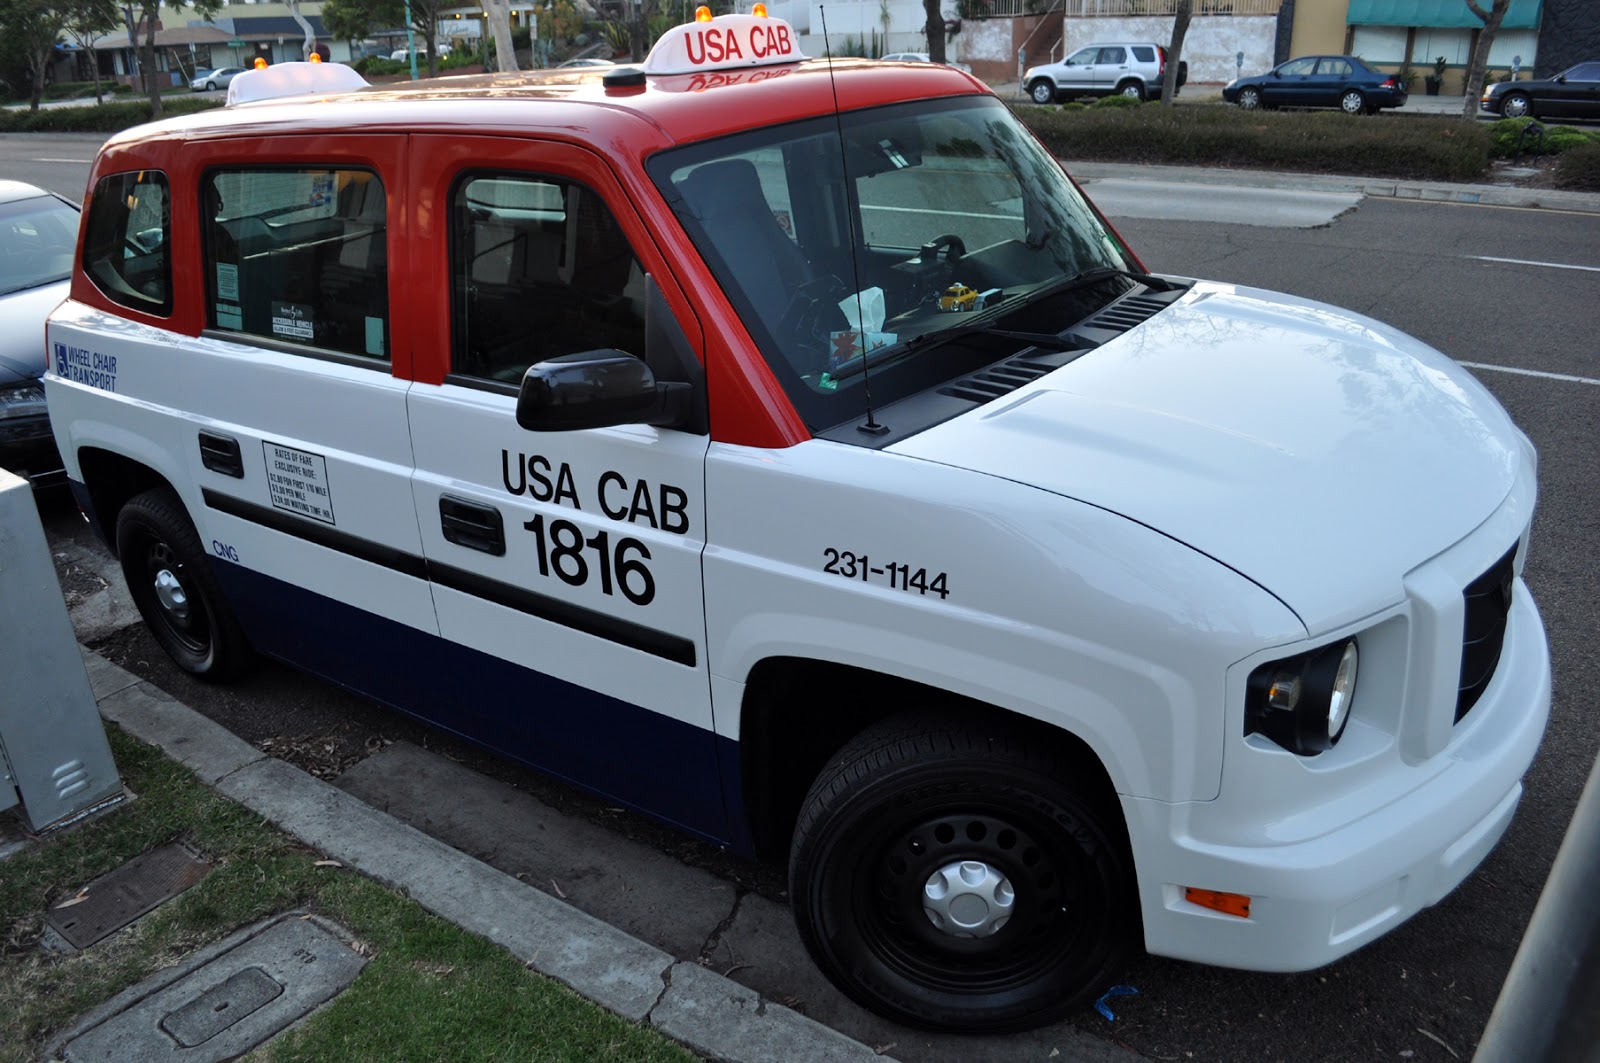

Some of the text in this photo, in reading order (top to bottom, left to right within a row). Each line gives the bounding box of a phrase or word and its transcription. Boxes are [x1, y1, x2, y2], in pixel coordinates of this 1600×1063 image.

[684, 25, 792, 65] USA CAB
[68, 346, 117, 374] WHEEL CHAIR
[68, 364, 116, 392] TRANSPORT
[275, 448, 313, 466] RATES OF FARE
[275, 460, 302, 475] EXCLUSIVE
[283, 476, 292, 487] FOR
[292, 478, 305, 490] FIRST
[315, 486, 327, 497] MILE
[285, 487, 294, 498] PER
[294, 490, 307, 502] MILE
[501, 449, 690, 535] USA CAB
[290, 499, 310, 512] WAITING
[309, 505, 322, 516] TIME
[212, 539, 239, 563] CNG
[523, 513, 656, 606] 1816
[822, 547, 950, 600] 231-1144
